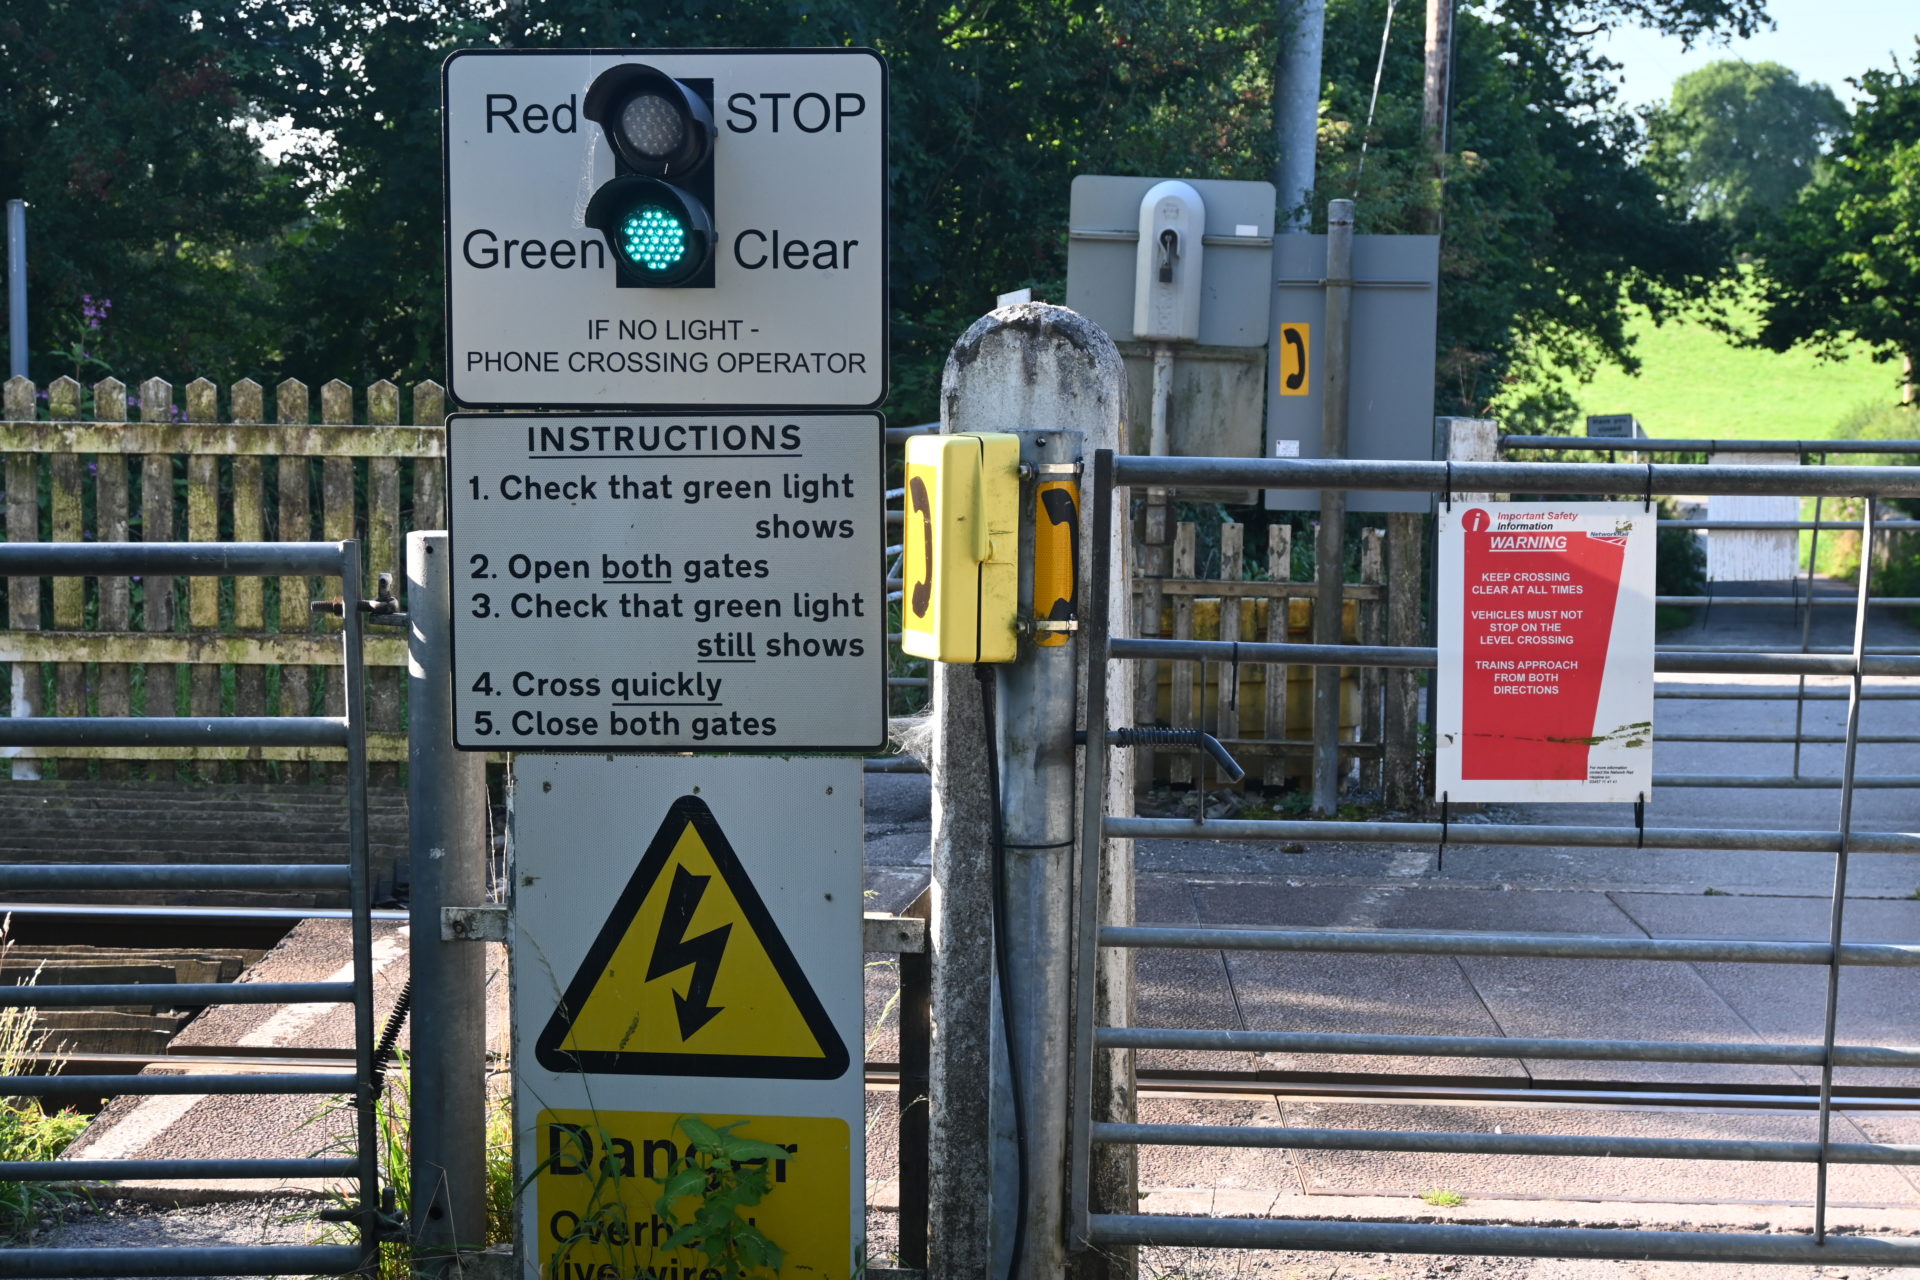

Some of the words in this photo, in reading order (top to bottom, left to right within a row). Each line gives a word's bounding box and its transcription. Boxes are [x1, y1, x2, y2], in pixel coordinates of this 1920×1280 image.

[486, 94, 577, 133] Red
[726, 93, 866, 133] STOP
[463, 229, 605, 269] Green
[733, 229, 859, 269] Clear
[588, 320, 610, 339] IF
[619, 320, 657, 340] NO
[666, 320, 744, 340] LIGHT
[467, 352, 560, 372] PHONE
[568, 352, 708, 372] CROSSING
[717, 353, 866, 373] OPERATOR
[528, 425, 801, 451] INSTRUCTIONS
[469, 476, 489, 500] 1.
[500, 475, 597, 500] Check
[608, 475, 673, 499] that
[683, 481, 771, 504] green
[783, 474, 854, 503] light
[755, 514, 854, 538] shows
[1498, 512, 1545, 521] Important
[1548, 512, 1577, 521] Safety
[1498, 522, 1553, 530] Information
[1491, 536, 1568, 548] WARNING
[469, 554, 497, 578] 2.
[508, 554, 590, 583] Open
[602, 554, 672, 578] both
[683, 554, 770, 583] gates
[1482, 573, 1511, 581] KEEP
[1514, 573, 1571, 581] CROSSING
[1472, 586, 1509, 594] CLEAR
[1511, 586, 1525, 594] AT
[1527, 586, 1548, 594] ALL
[1552, 586, 1583, 594] TIMES
[471, 593, 500, 618] 3.
[510, 593, 608, 618] Check
[618, 593, 684, 617] that
[693, 599, 781, 622] green
[793, 593, 865, 622] light
[1472, 611, 1525, 619] VEHICLES
[1528, 611, 1558, 619] MUST
[1561, 611, 1584, 619] NOT
[1490, 624, 1519, 632] STOP
[1522, 624, 1538, 632] ON
[1541, 623, 1561, 631] THE
[697, 632, 756, 657] still
[766, 632, 865, 657] shows
[1481, 636, 1514, 644] LEVEL
[1518, 636, 1574, 644] CROSSING
[1476, 661, 1515, 669] TRAINS
[1518, 661, 1578, 669] APPROACH
[471, 672, 502, 696] 4.
[512, 672, 601, 696] Cross
[611, 672, 722, 701] quickly
[1495, 674, 1526, 682] FROM
[1529, 674, 1559, 682] BOTH
[1494, 686, 1559, 694] DIRECTIONS
[474, 711, 501, 735] 5.
[511, 711, 599, 735] Close
[610, 711, 680, 735] both
[691, 712, 777, 740] gates
[550, 1123, 798, 1193] Danr
[551, 1211, 756, 1248] Overh
[637, 1259, 747, 1280] ire
